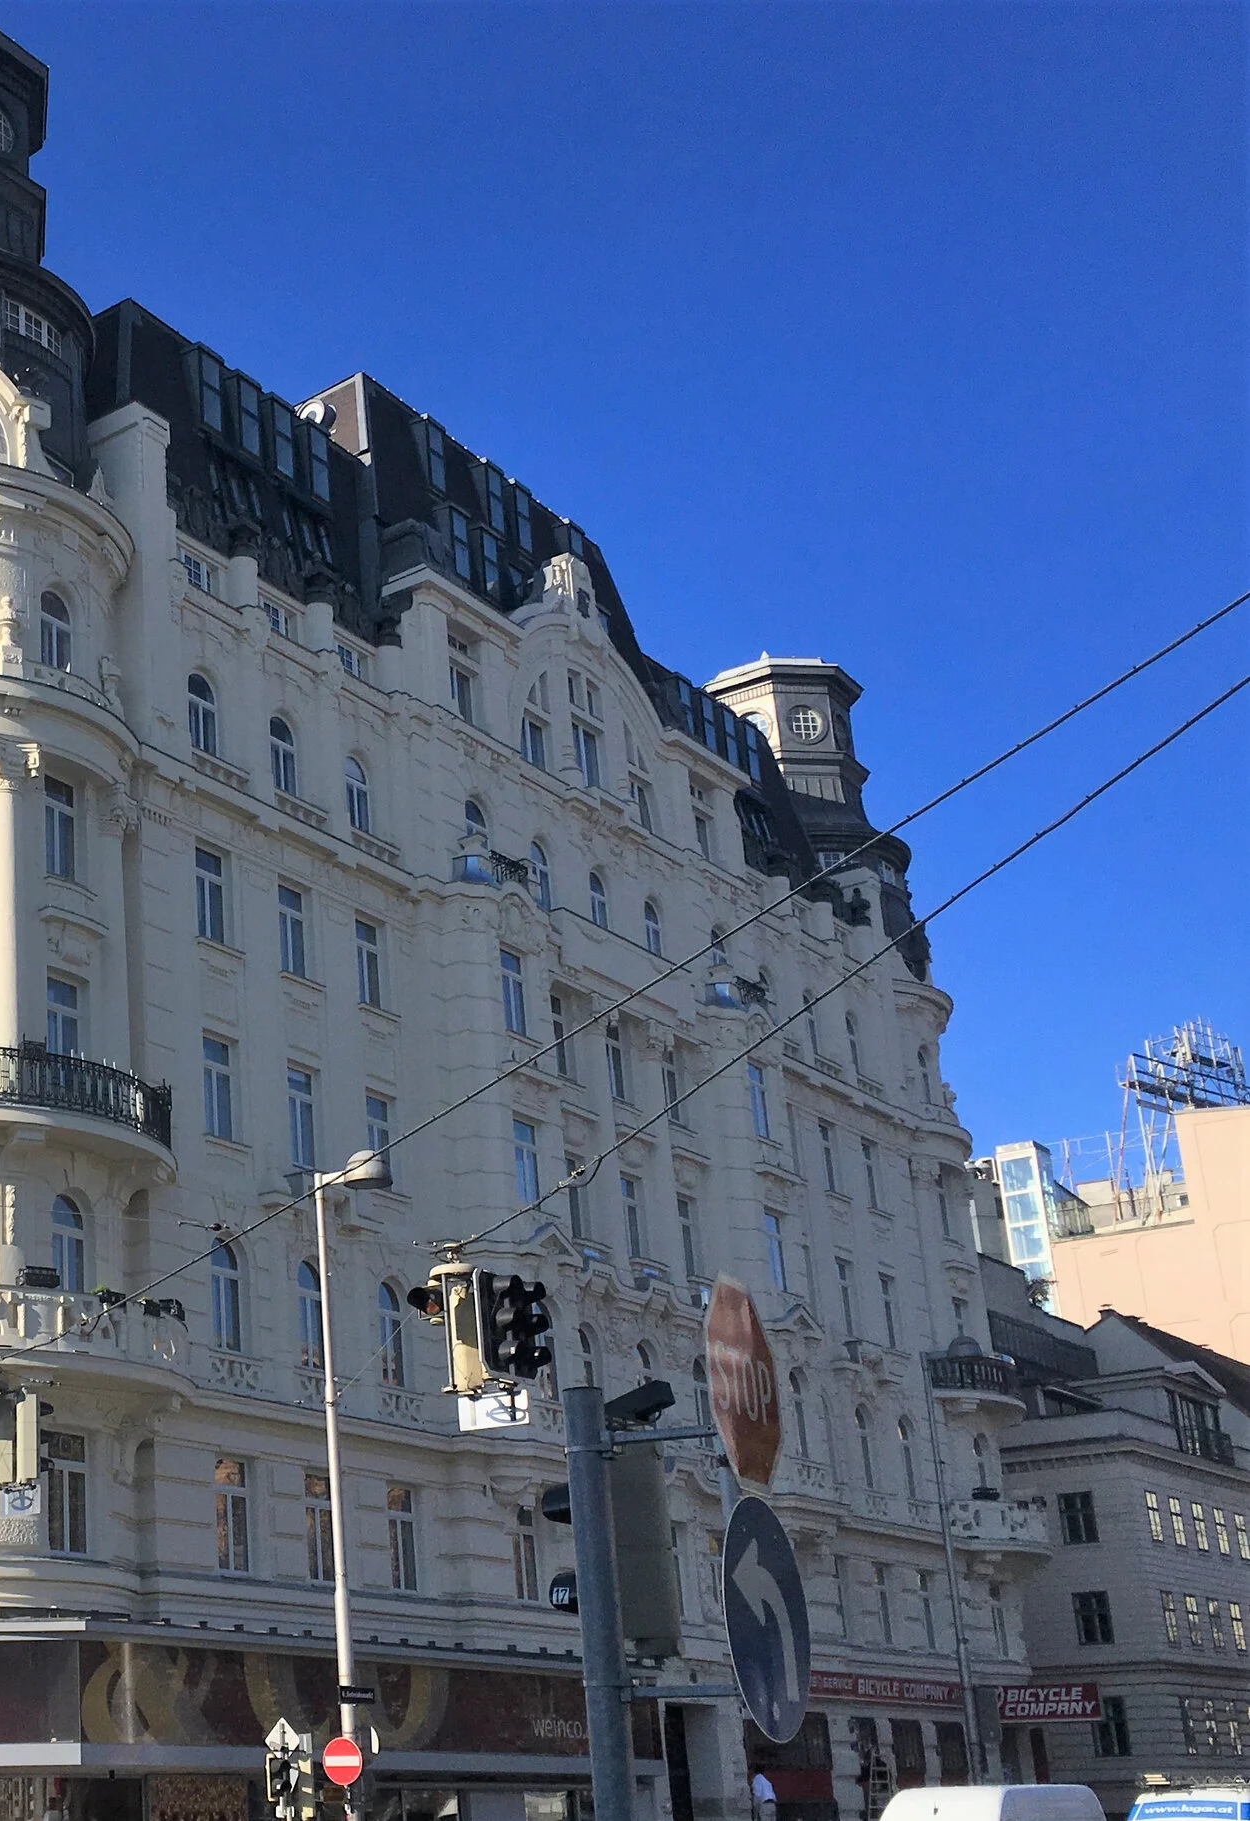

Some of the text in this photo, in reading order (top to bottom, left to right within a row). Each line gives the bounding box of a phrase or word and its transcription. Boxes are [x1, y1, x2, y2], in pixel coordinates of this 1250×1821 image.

[715, 1339, 771, 1426] STOP
[554, 1588, 568, 1603] 17
[857, 1679, 899, 1697] BICYCLE
[904, 1682, 949, 1700] COMPANY
[1006, 1687, 1083, 1702] BICYCLE
[1004, 1701, 1097, 1717] COMPANY
[1144, 1803, 1234, 1814] www.lugar.at
